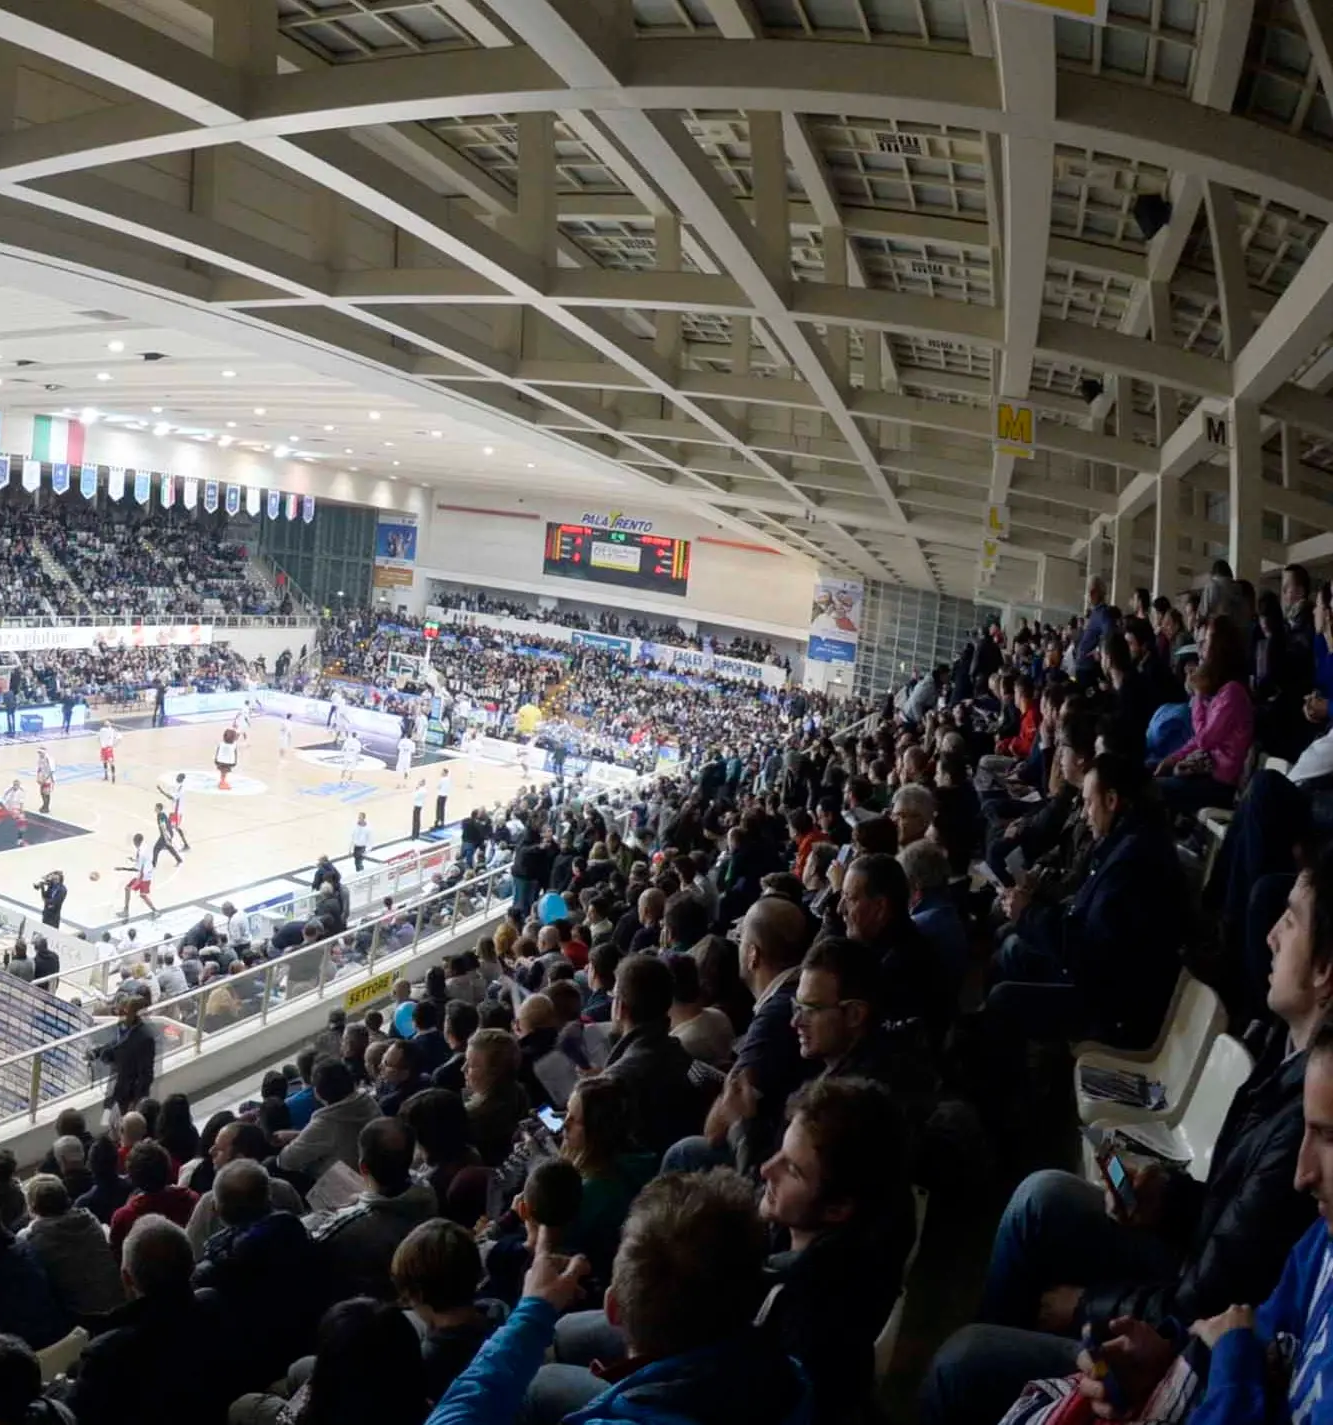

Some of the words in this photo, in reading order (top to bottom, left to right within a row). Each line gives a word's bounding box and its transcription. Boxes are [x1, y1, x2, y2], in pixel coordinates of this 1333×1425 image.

[998, 403, 1032, 443] M
[1207, 417, 1226, 446] M
[348, 975, 389, 1006] SETTORE
